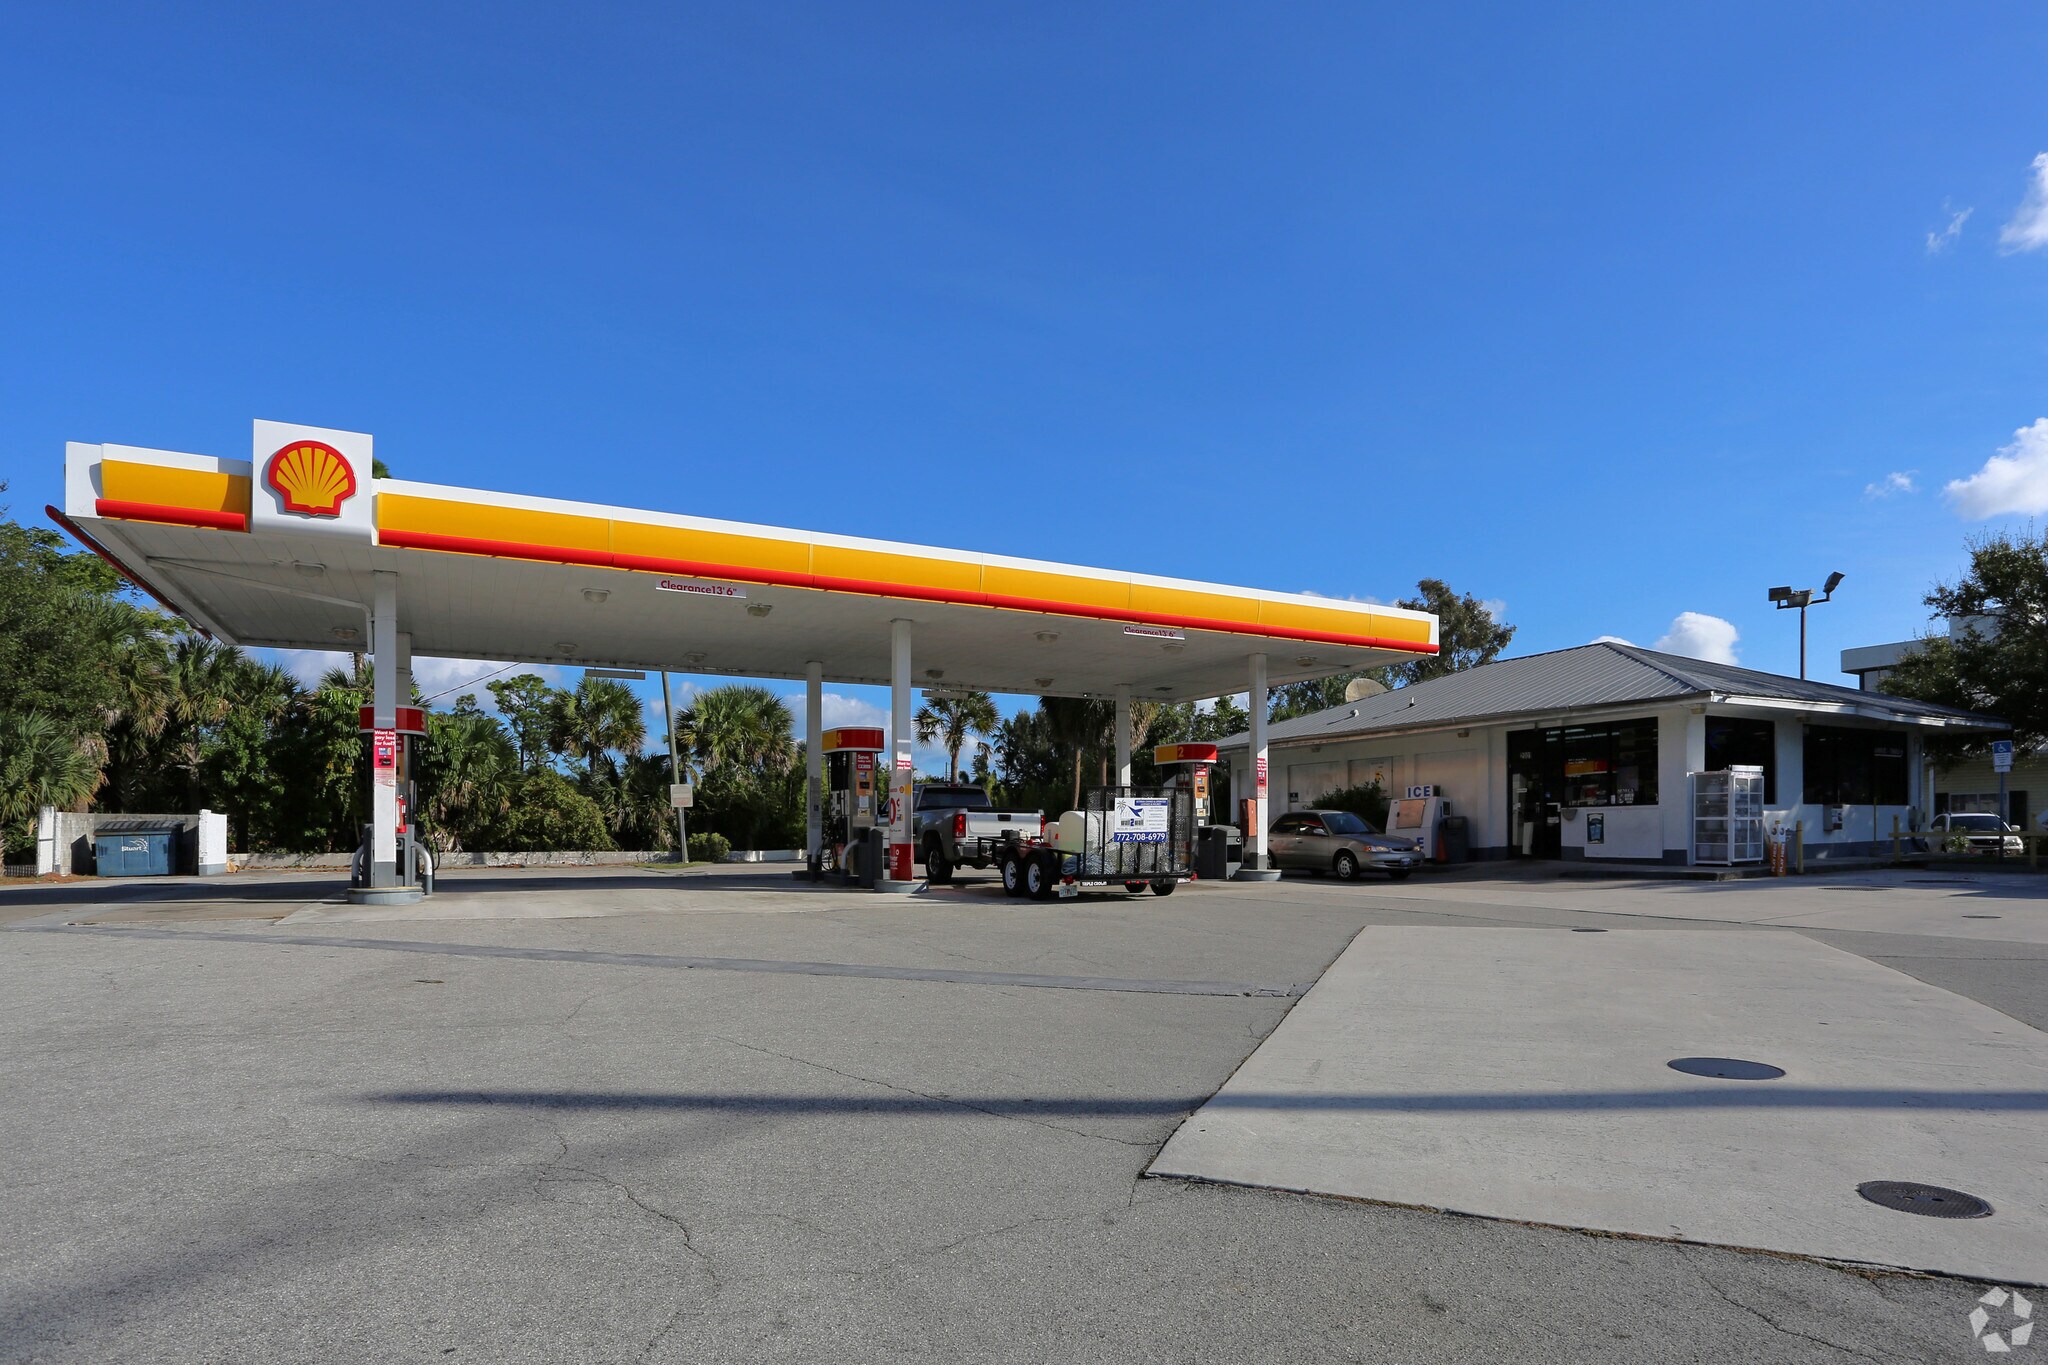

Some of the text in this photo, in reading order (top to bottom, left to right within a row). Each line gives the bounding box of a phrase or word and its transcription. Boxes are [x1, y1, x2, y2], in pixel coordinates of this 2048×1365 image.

[1177, 746, 1184, 758] 2
[1407, 785, 1431, 798] ICE
[1116, 832, 1166, 841] 772-708-6979
